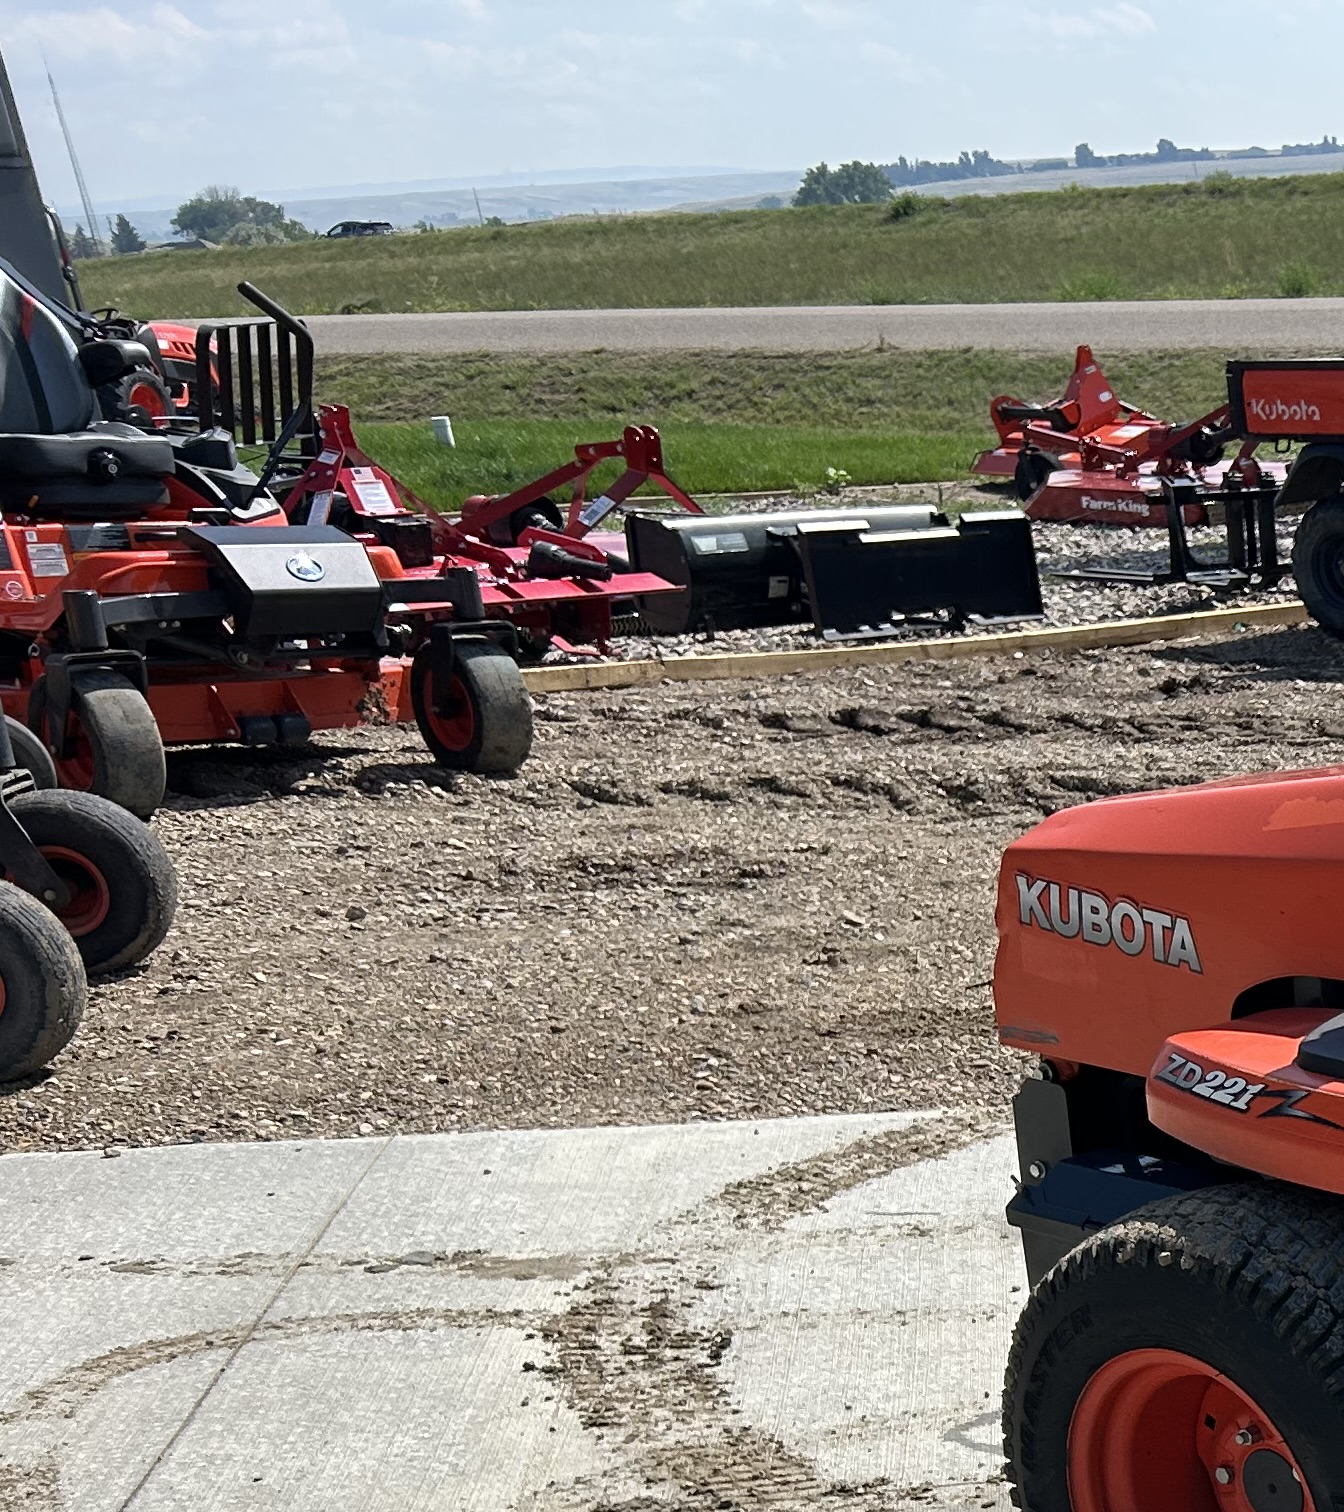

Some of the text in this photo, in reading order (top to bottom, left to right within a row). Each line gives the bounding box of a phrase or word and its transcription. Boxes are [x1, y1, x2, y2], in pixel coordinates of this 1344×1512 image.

[1250, 399, 1320, 421] Kubota
[1015, 873, 1203, 975] KUBOTA
[1155, 1053, 1267, 1113] ZD221
